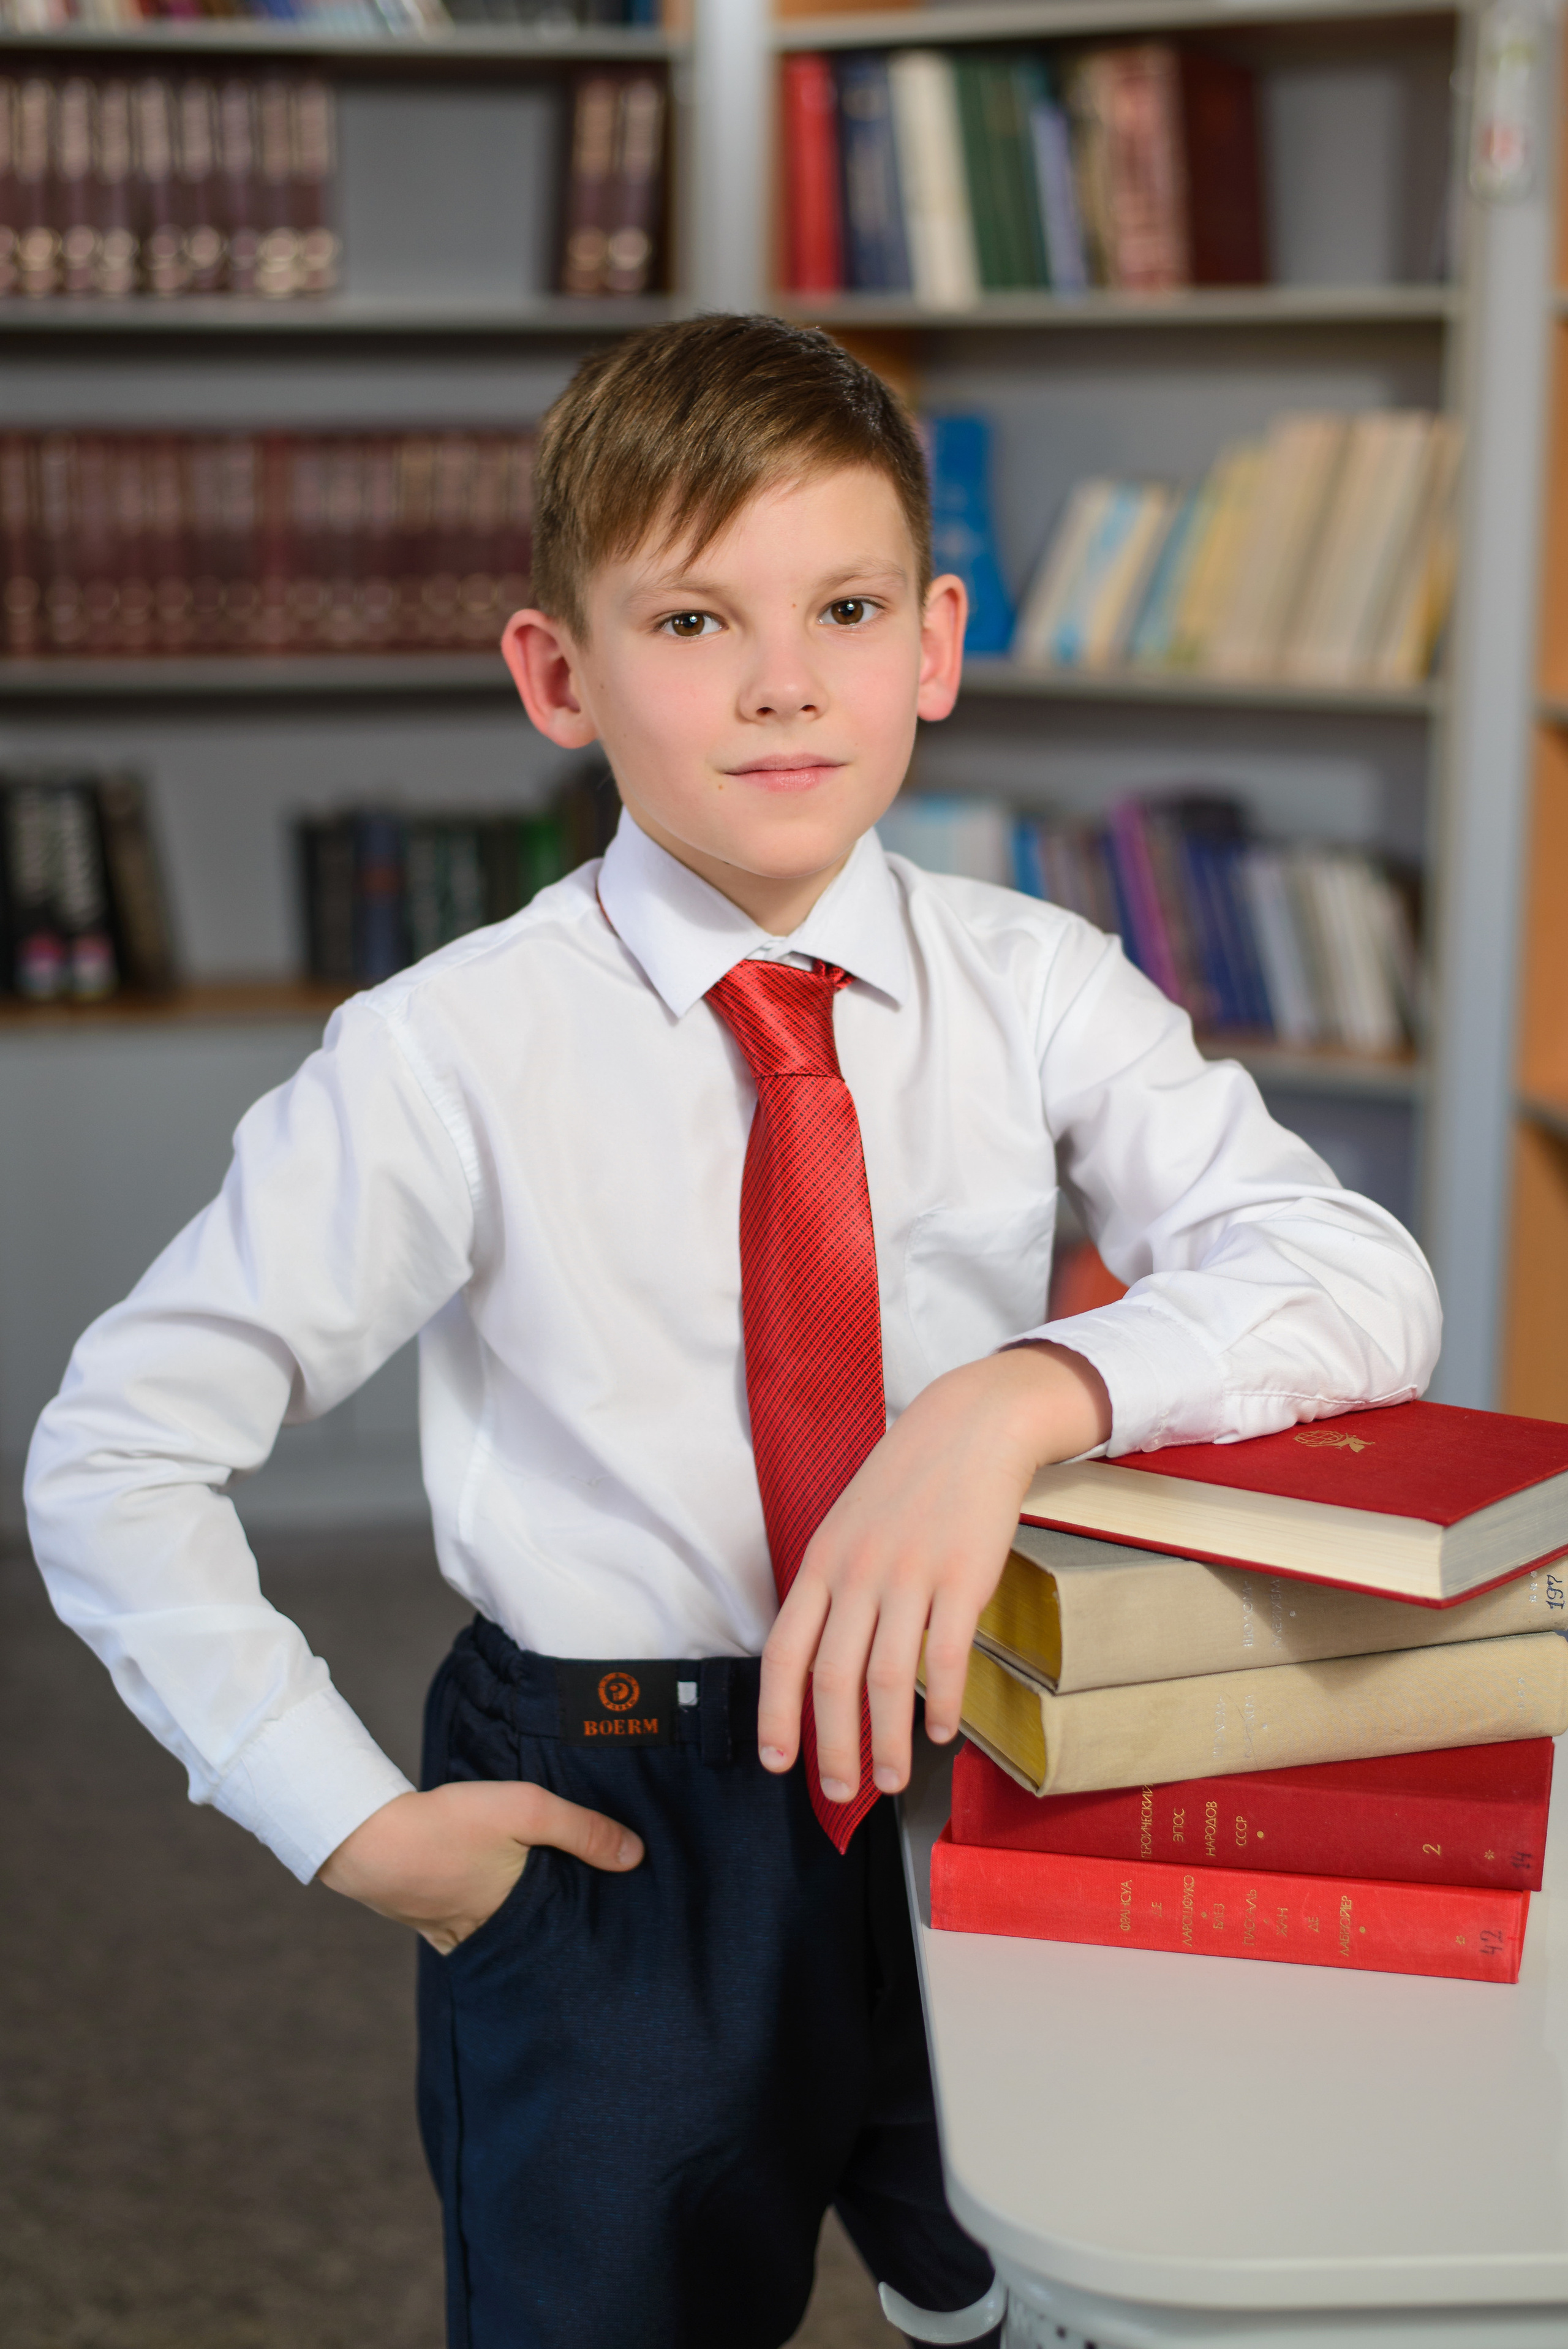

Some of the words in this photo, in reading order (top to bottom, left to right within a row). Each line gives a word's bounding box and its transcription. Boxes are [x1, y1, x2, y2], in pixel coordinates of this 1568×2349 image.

[1546, 1574, 1564, 1610] 197
[584, 1718, 659, 1736] BOERM
[1173, 1807, 1185, 1842] ЭПОС
[1205, 1801, 1217, 1856] НАРОДОВ
[1235, 1815, 1247, 1847] СССР
[1422, 1844, 1441, 1856] 2
[1308, 1916, 1319, 1933] ДЕ
[1479, 1929, 1503, 1955] 42
